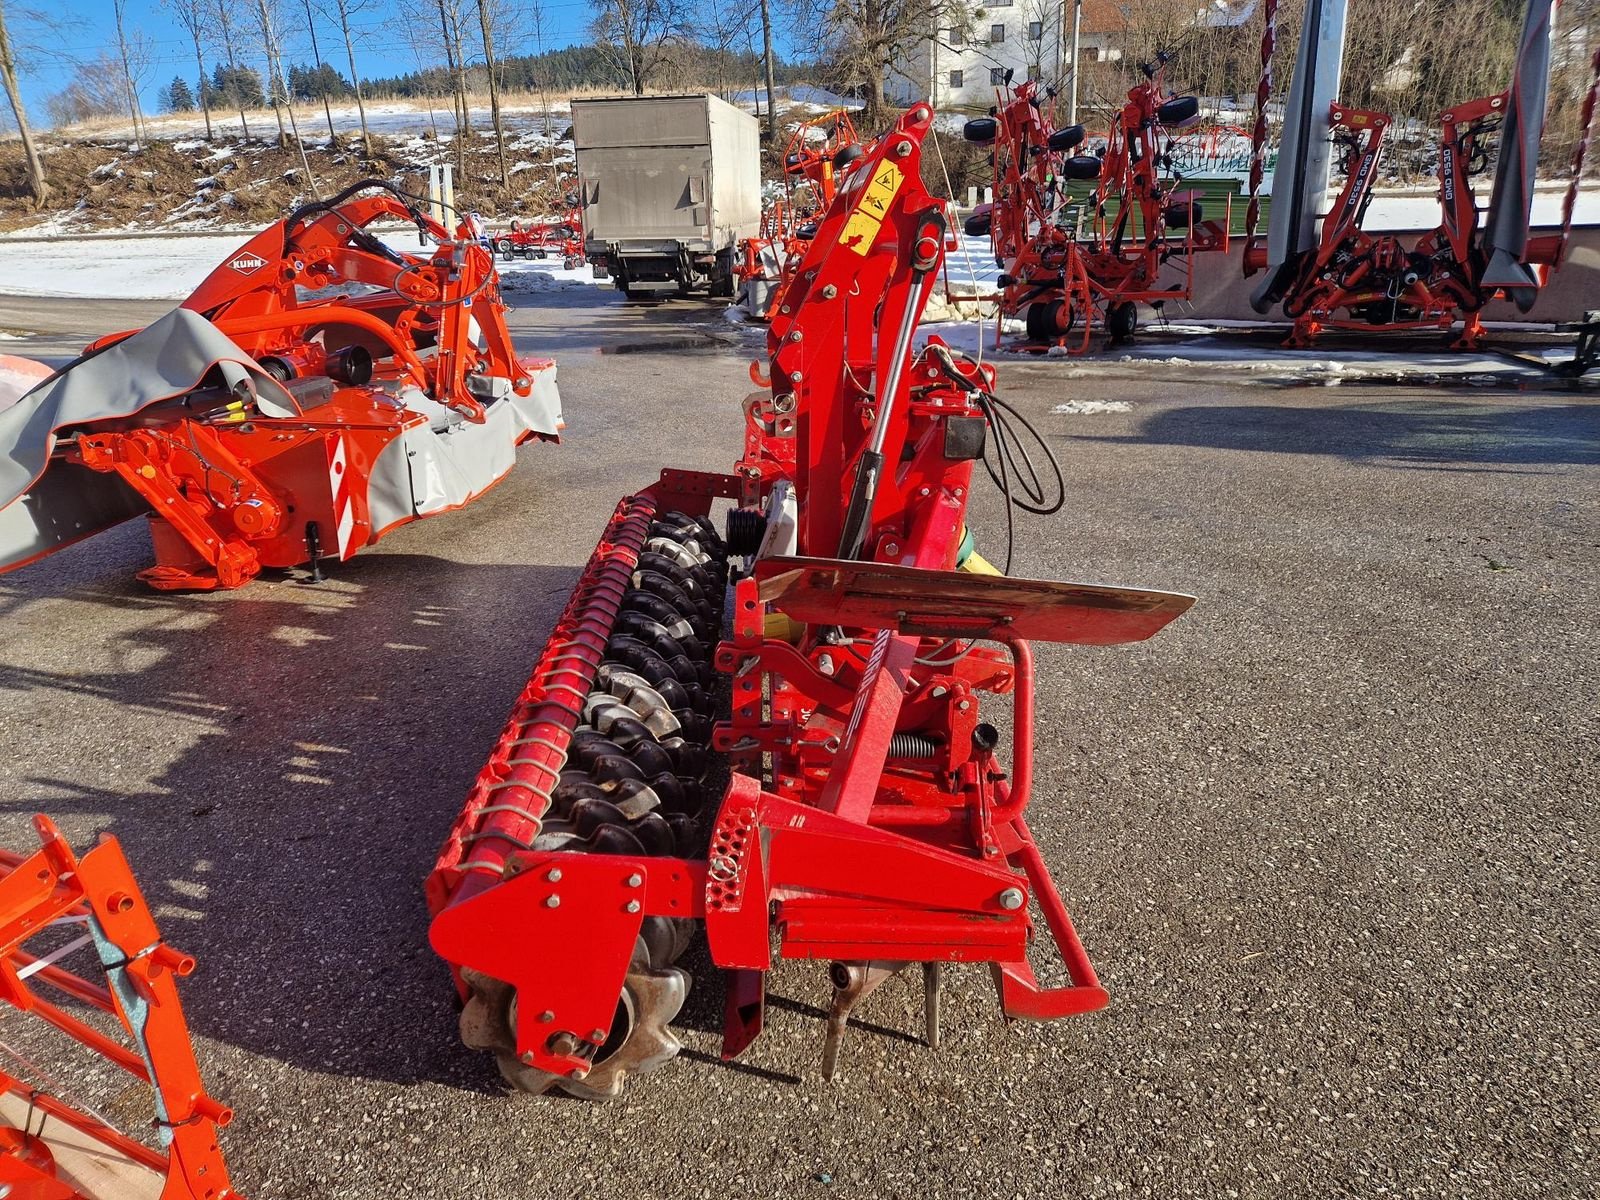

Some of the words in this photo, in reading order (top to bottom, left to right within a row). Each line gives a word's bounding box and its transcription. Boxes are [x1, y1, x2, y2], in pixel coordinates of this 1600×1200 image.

[1360, 154, 1372, 176] GMD
[1443, 149, 1452, 175] 9530
[1349, 179, 1363, 204] 9530
[1445, 178, 1453, 200] GMD
[233, 260, 261, 269] KUHN
